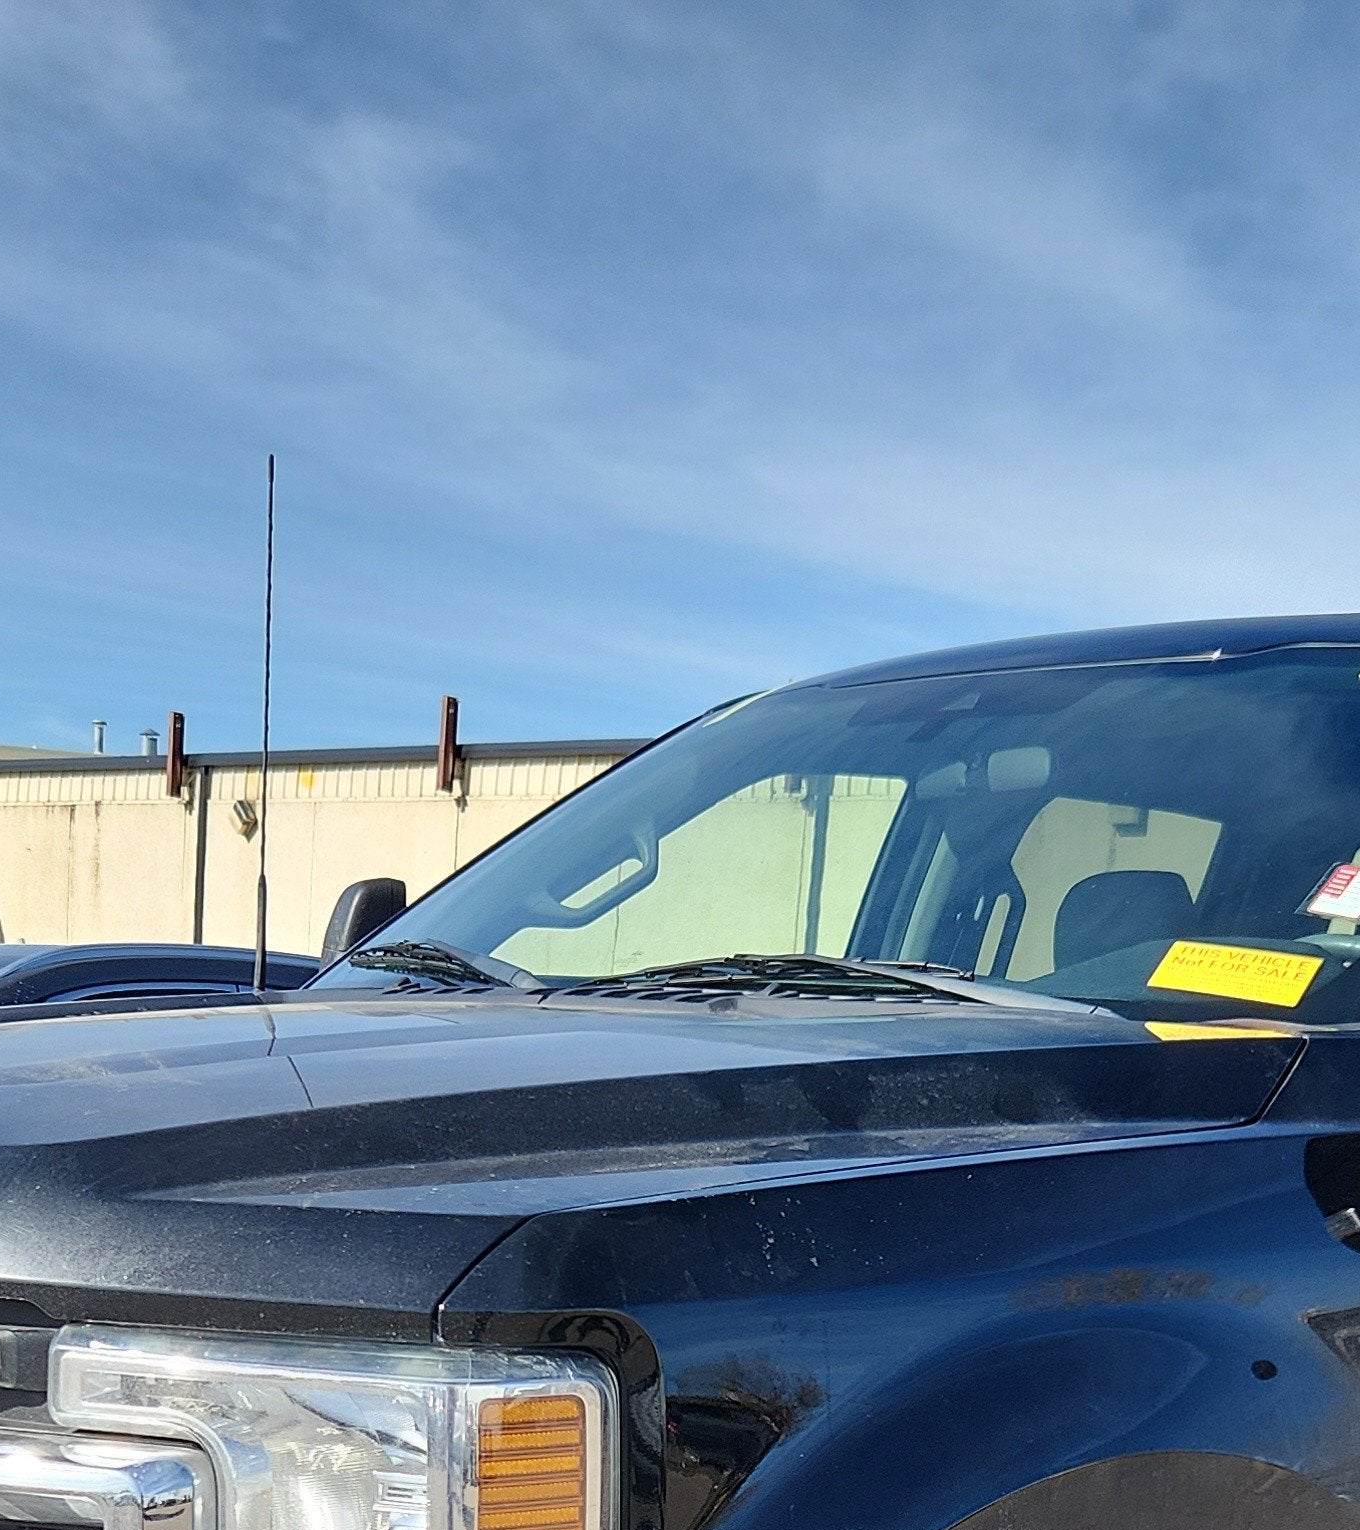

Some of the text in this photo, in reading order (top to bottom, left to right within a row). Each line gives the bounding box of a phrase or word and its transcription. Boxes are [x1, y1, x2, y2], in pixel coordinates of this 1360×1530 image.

[1181, 946, 1311, 970] THIS VEHICLE
[1208, 960, 1249, 974] FOR
[1253, 967, 1306, 982] SALE
